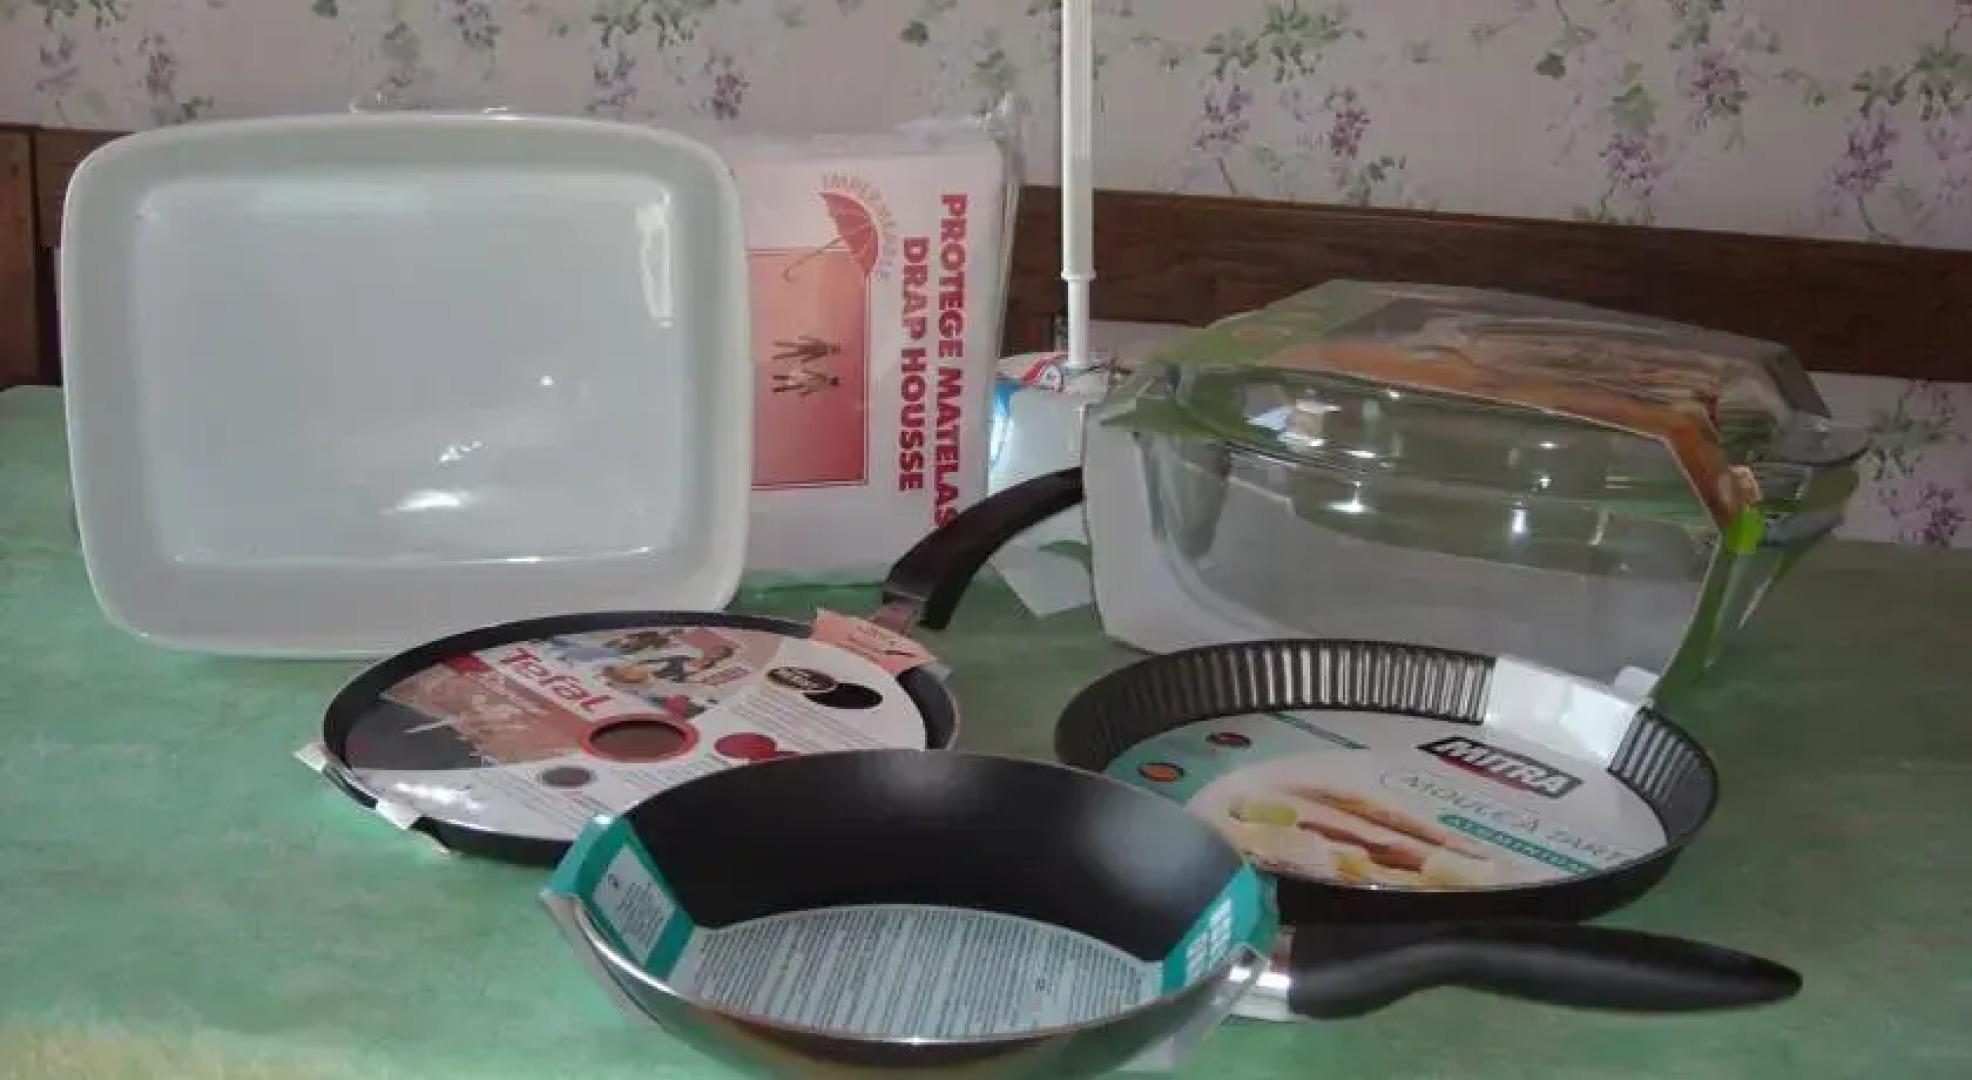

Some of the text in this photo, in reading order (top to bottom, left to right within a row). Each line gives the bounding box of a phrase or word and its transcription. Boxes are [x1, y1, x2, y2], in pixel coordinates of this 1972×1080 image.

[899, 236, 930, 492] DRAP HOUSSE
[932, 193, 969, 528] PROTEGE MATELAS
[498, 647, 612, 712] Tefal
[1431, 741, 1569, 797] MITRA
